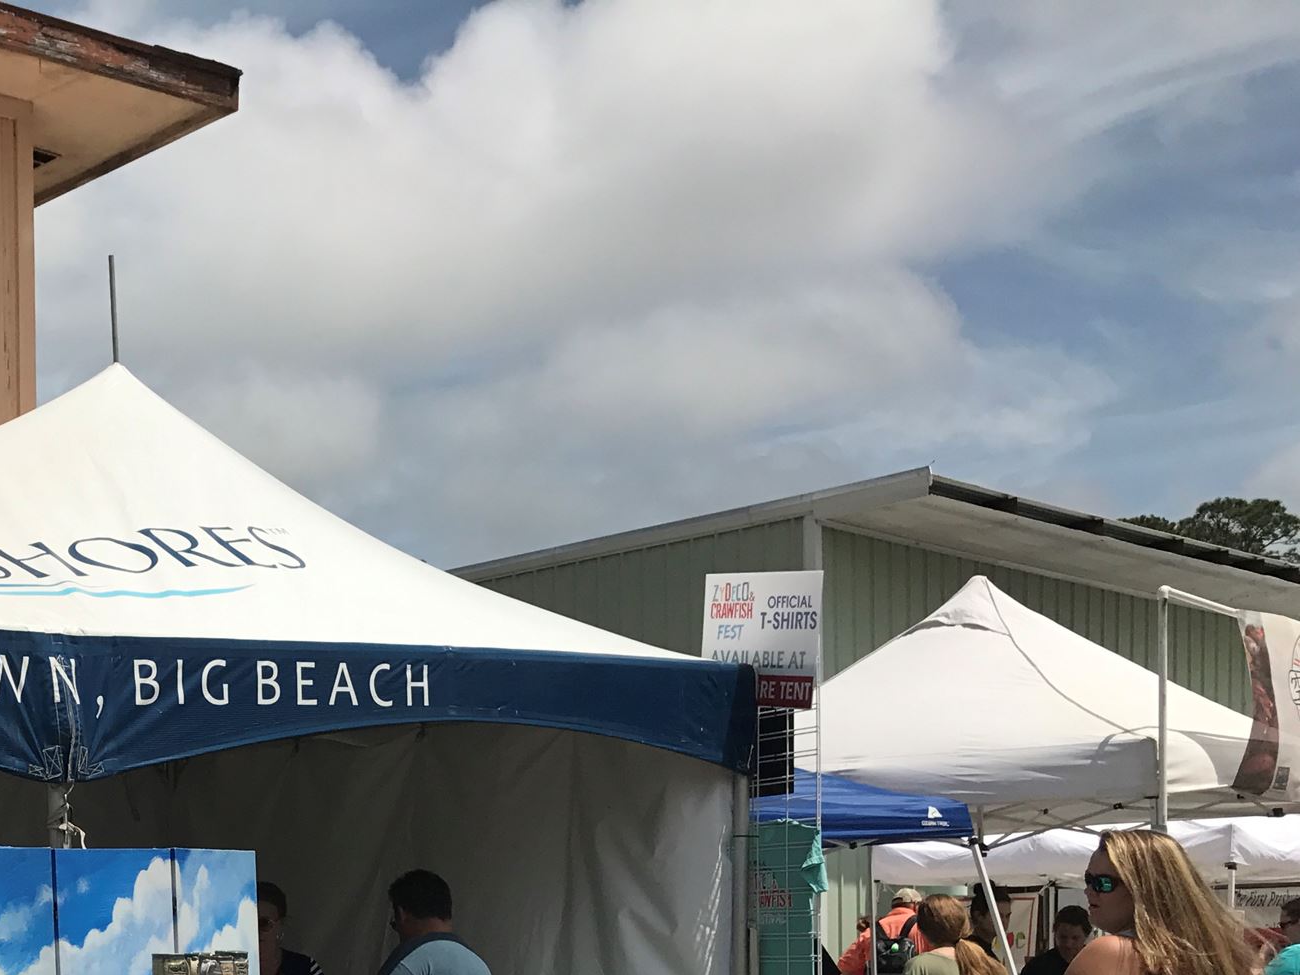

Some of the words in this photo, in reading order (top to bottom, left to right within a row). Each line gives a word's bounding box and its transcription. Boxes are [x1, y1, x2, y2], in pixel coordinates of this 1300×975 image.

[712, 582, 749, 602] ZYDECO
[710, 602, 753, 619] CRAWFISH
[767, 595, 812, 609] OFFICIAL
[760, 611, 818, 630] T-SHIRTS
[716, 624, 745, 641] FEST
[711, 649, 786, 669] AVAILABLE
[787, 651, 806, 669] AT
[133, 657, 230, 707] BIG
[256, 660, 431, 708] BEACH
[759, 680, 777, 699] RE
[780, 681, 812, 701] TENT
